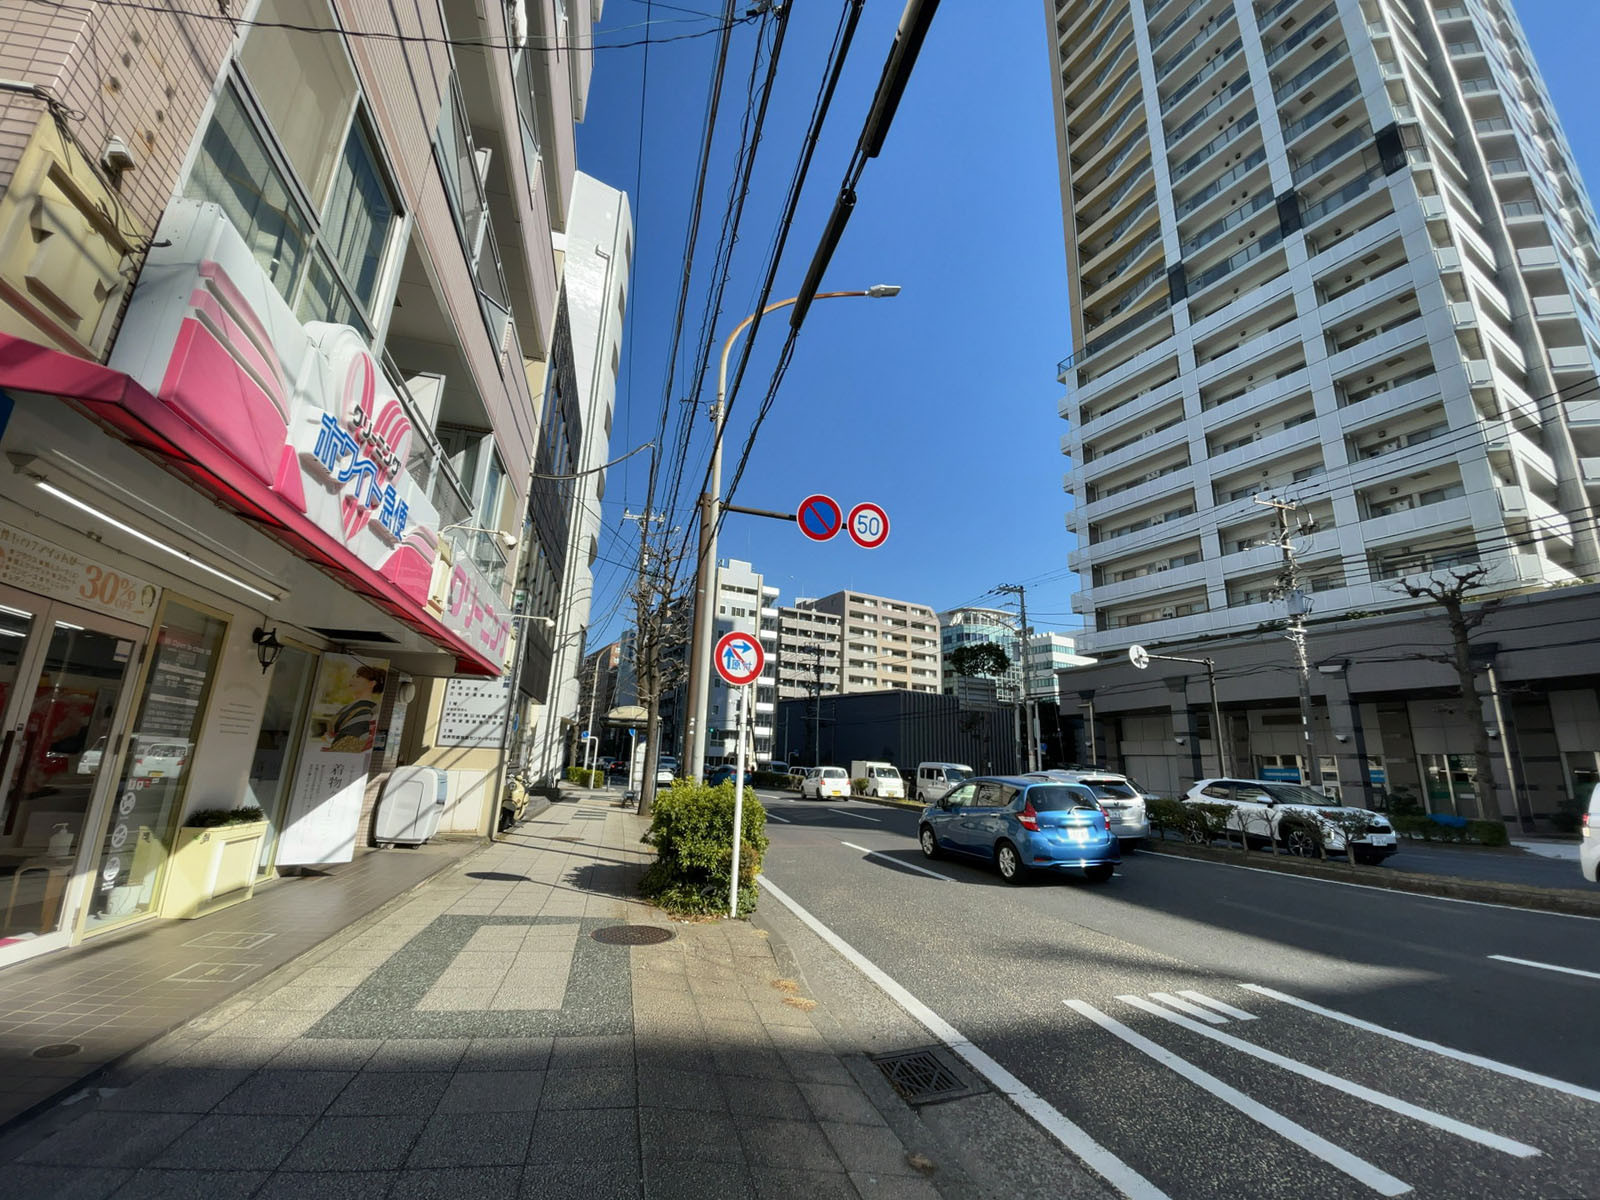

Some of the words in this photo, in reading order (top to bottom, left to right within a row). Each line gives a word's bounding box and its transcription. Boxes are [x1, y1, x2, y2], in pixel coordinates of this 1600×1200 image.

[353, 404, 401, 476] クリーニング
[313, 411, 409, 542] ホワイト急便
[857, 514, 880, 537] 50
[79, 564, 137, 605] 30%
